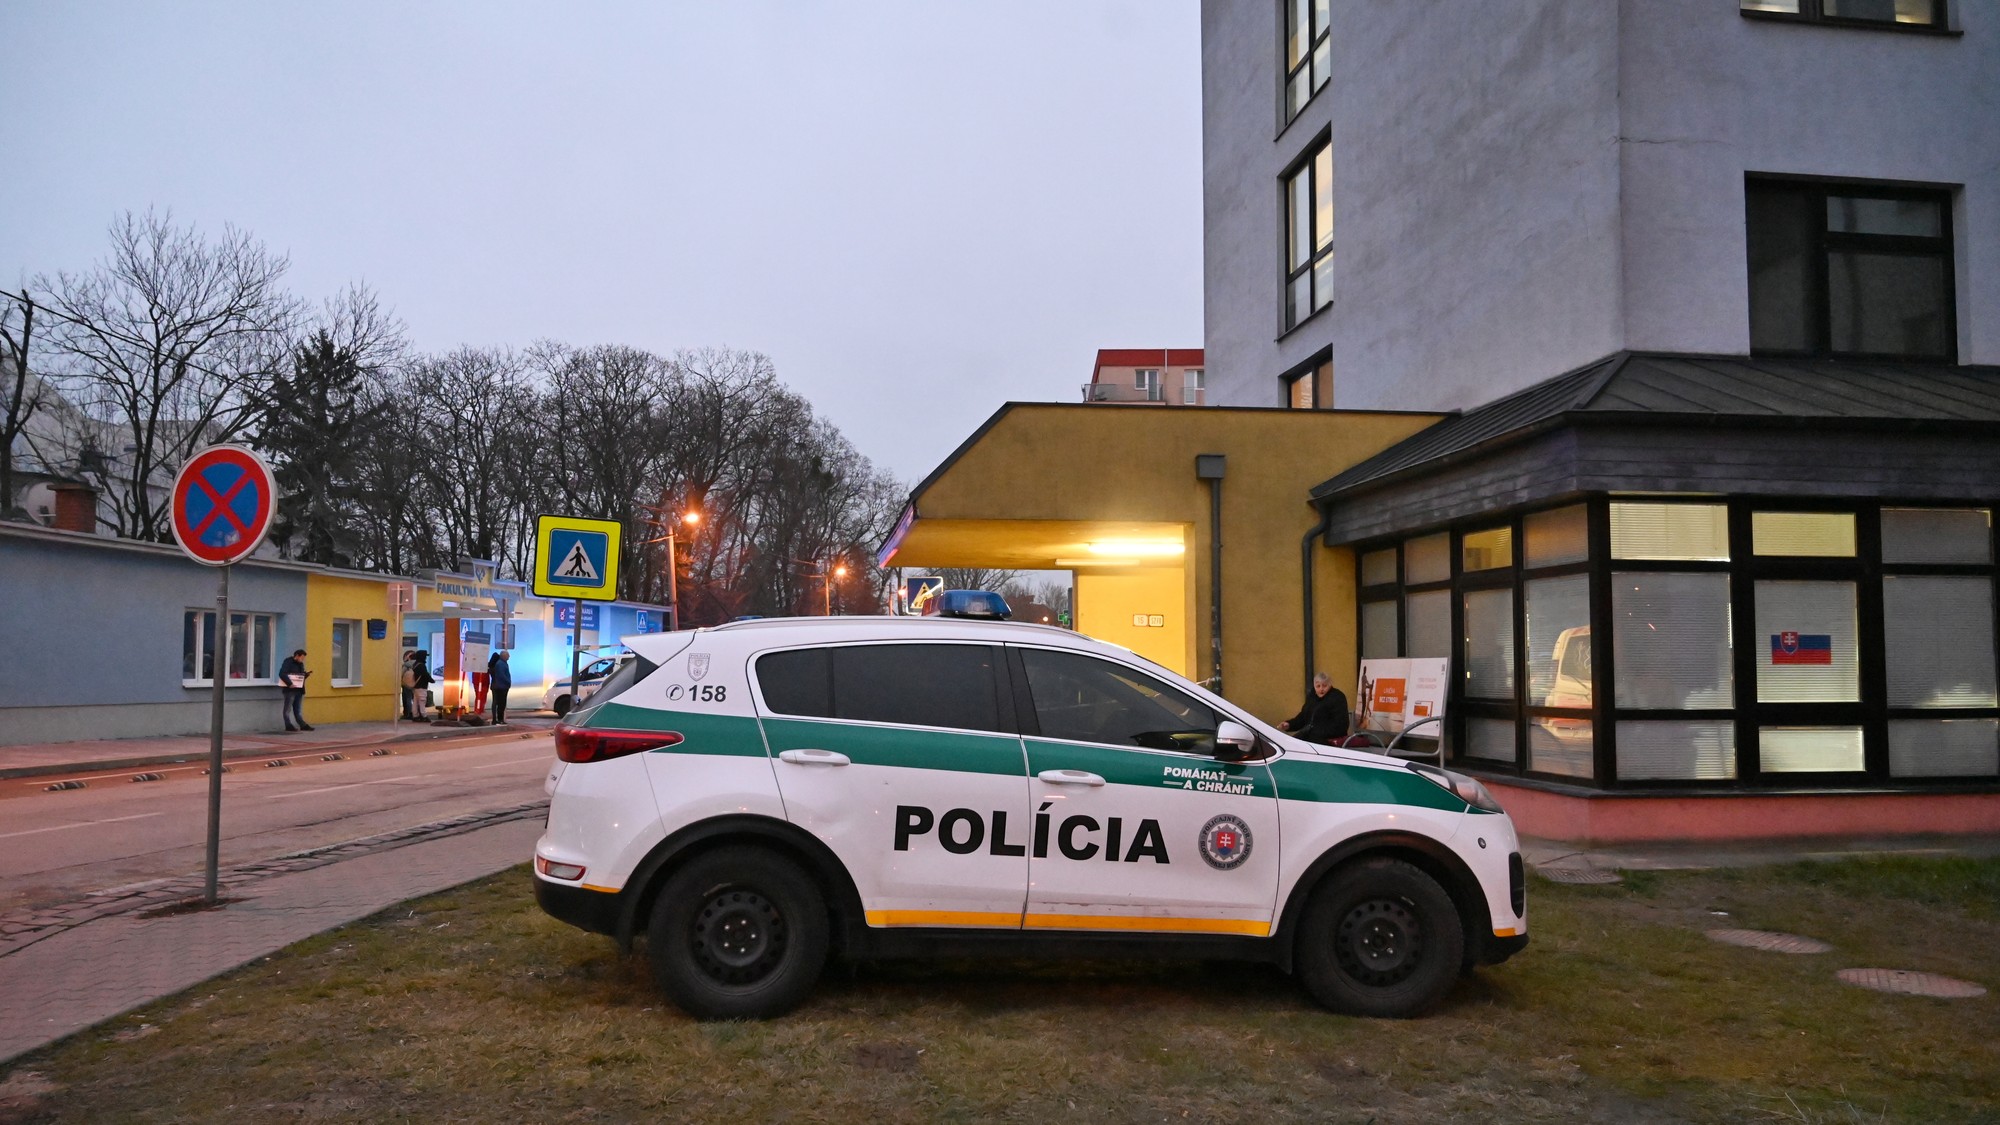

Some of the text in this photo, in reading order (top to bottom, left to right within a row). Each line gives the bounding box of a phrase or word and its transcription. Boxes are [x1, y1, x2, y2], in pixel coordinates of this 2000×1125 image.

[688, 684, 727, 702] 158
[1163, 766, 1227, 781] POMÁHAŤ
[1183, 779, 1254, 795] A CHRÁNIŤ
[894, 801, 1170, 864] POLÍCIA
